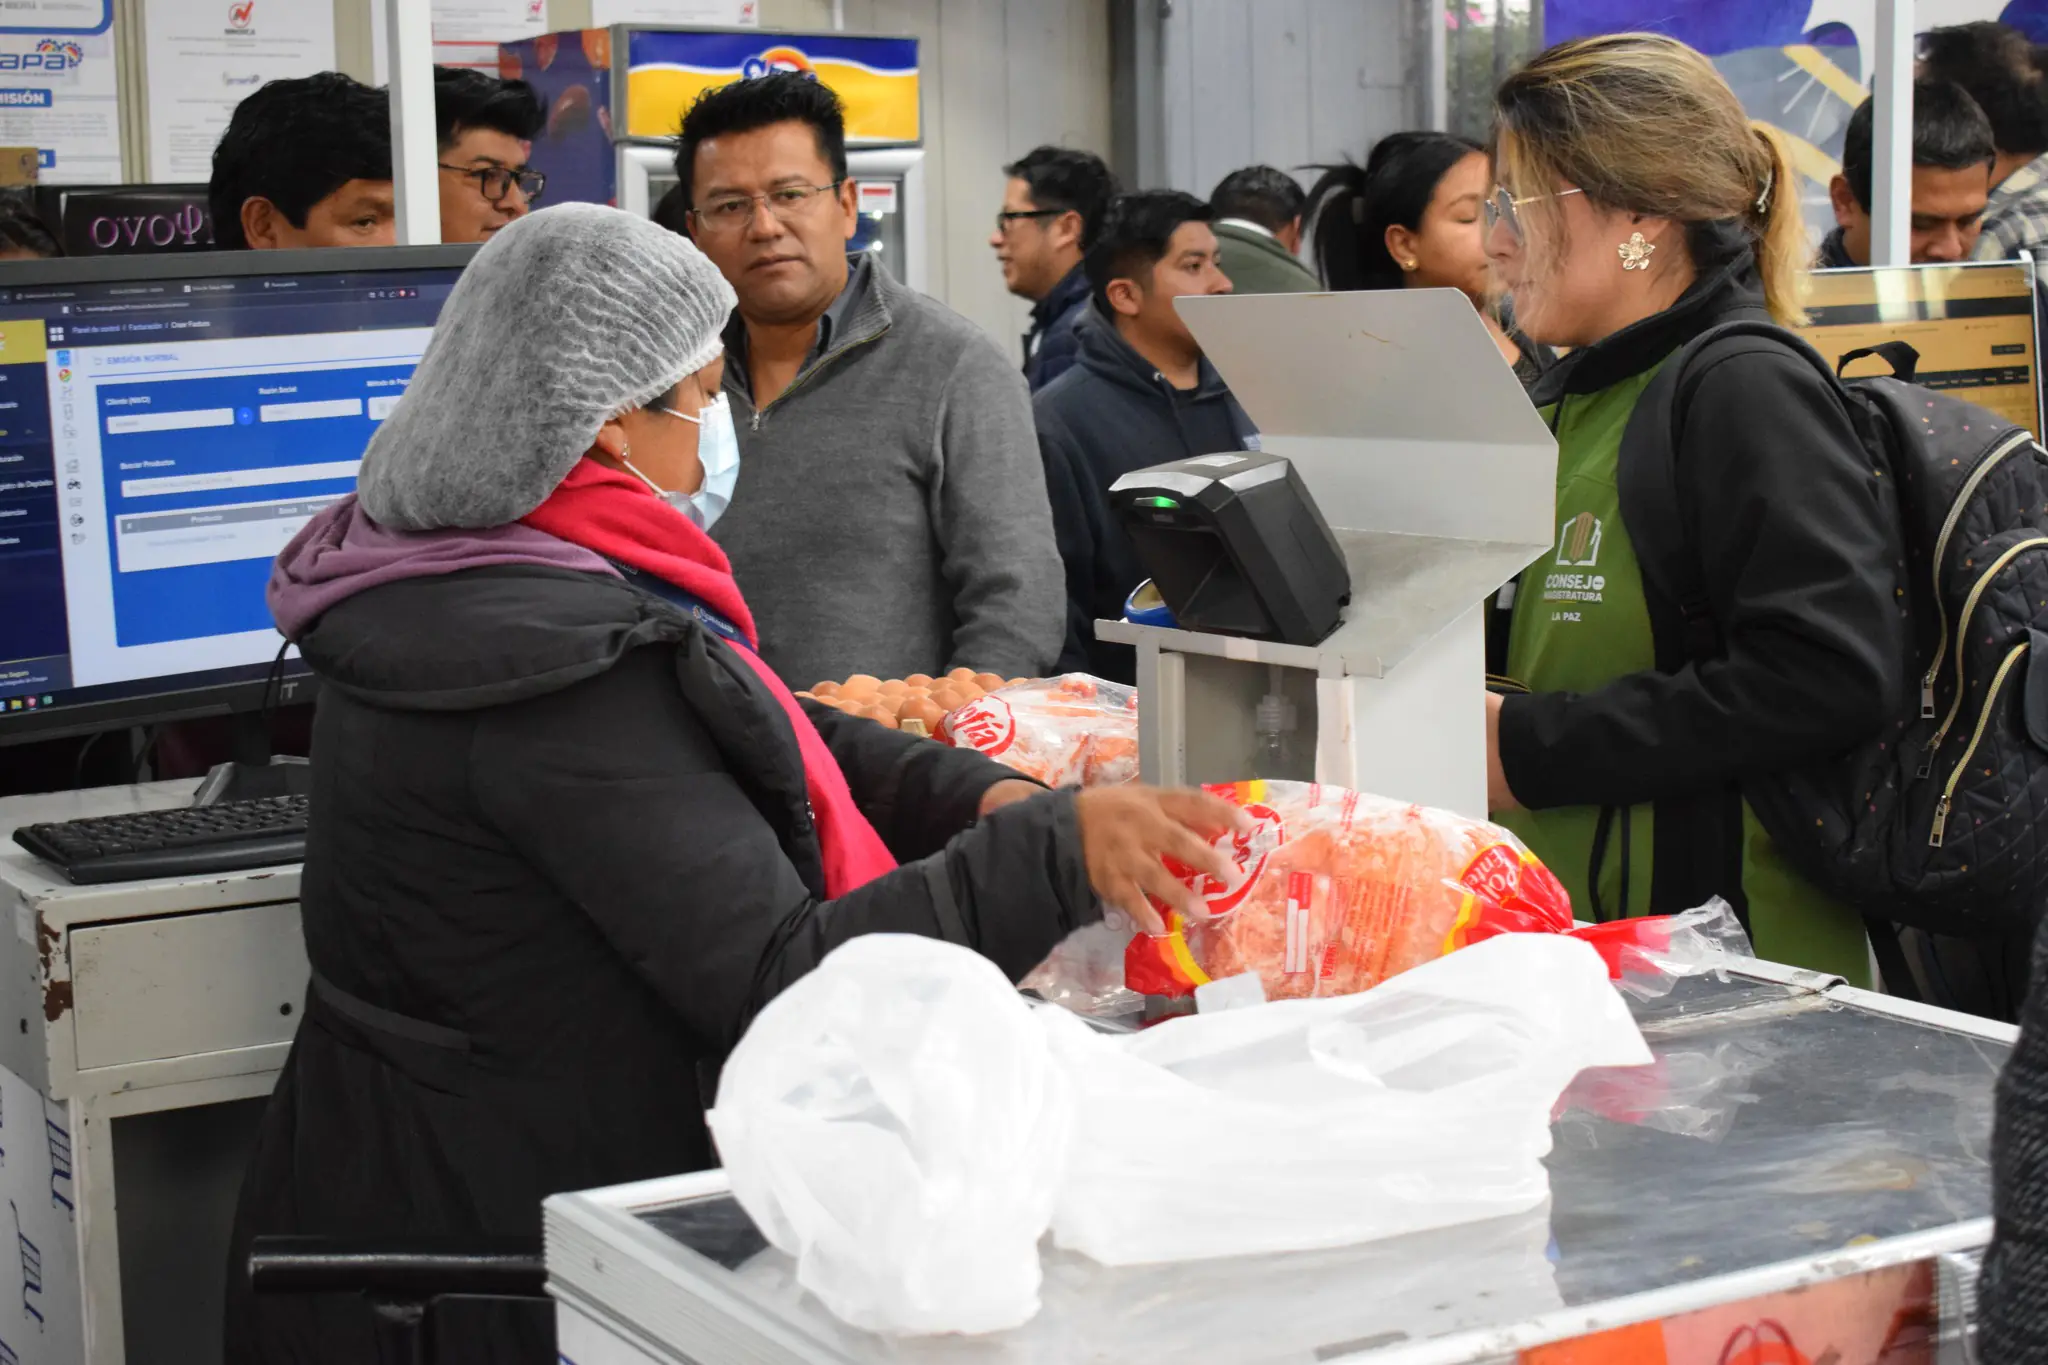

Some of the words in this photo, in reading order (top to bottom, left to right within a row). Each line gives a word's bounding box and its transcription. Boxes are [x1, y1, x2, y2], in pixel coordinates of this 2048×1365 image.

[1545, 574, 1606, 590] CONSEJO
[1551, 611, 1561, 621] LA
[1563, 611, 1582, 622] PAZ
